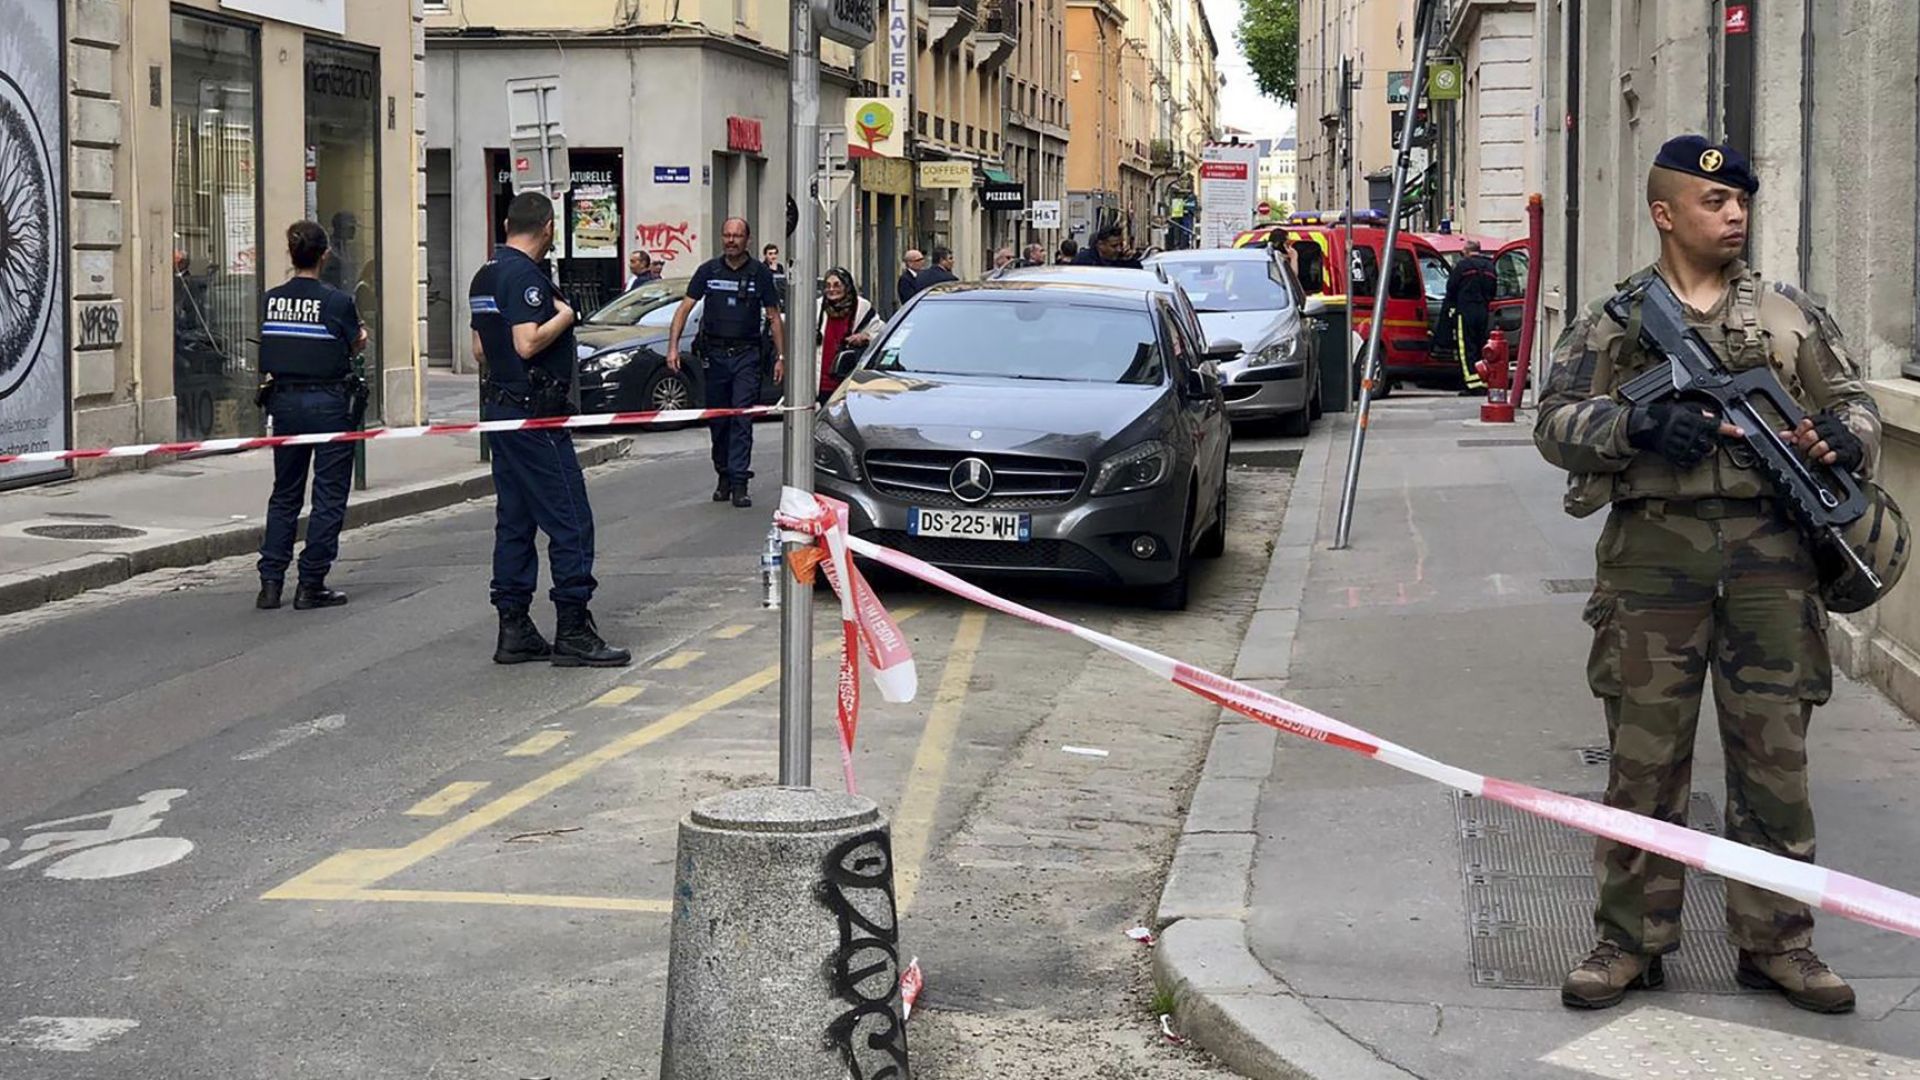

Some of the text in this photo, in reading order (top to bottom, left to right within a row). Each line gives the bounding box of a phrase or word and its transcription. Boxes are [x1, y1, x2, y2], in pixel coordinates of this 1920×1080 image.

[890, 0, 906, 98] LAVERI
[922, 164, 970, 176] COIFFEUR
[571, 171, 612, 182] ATURELLE
[985, 191, 1021, 201] PIZZERIA
[1034, 209, 1058, 220] H&T
[268, 296, 322, 314] POLICE
[921, 511, 1016, 536] DS-225-WH
